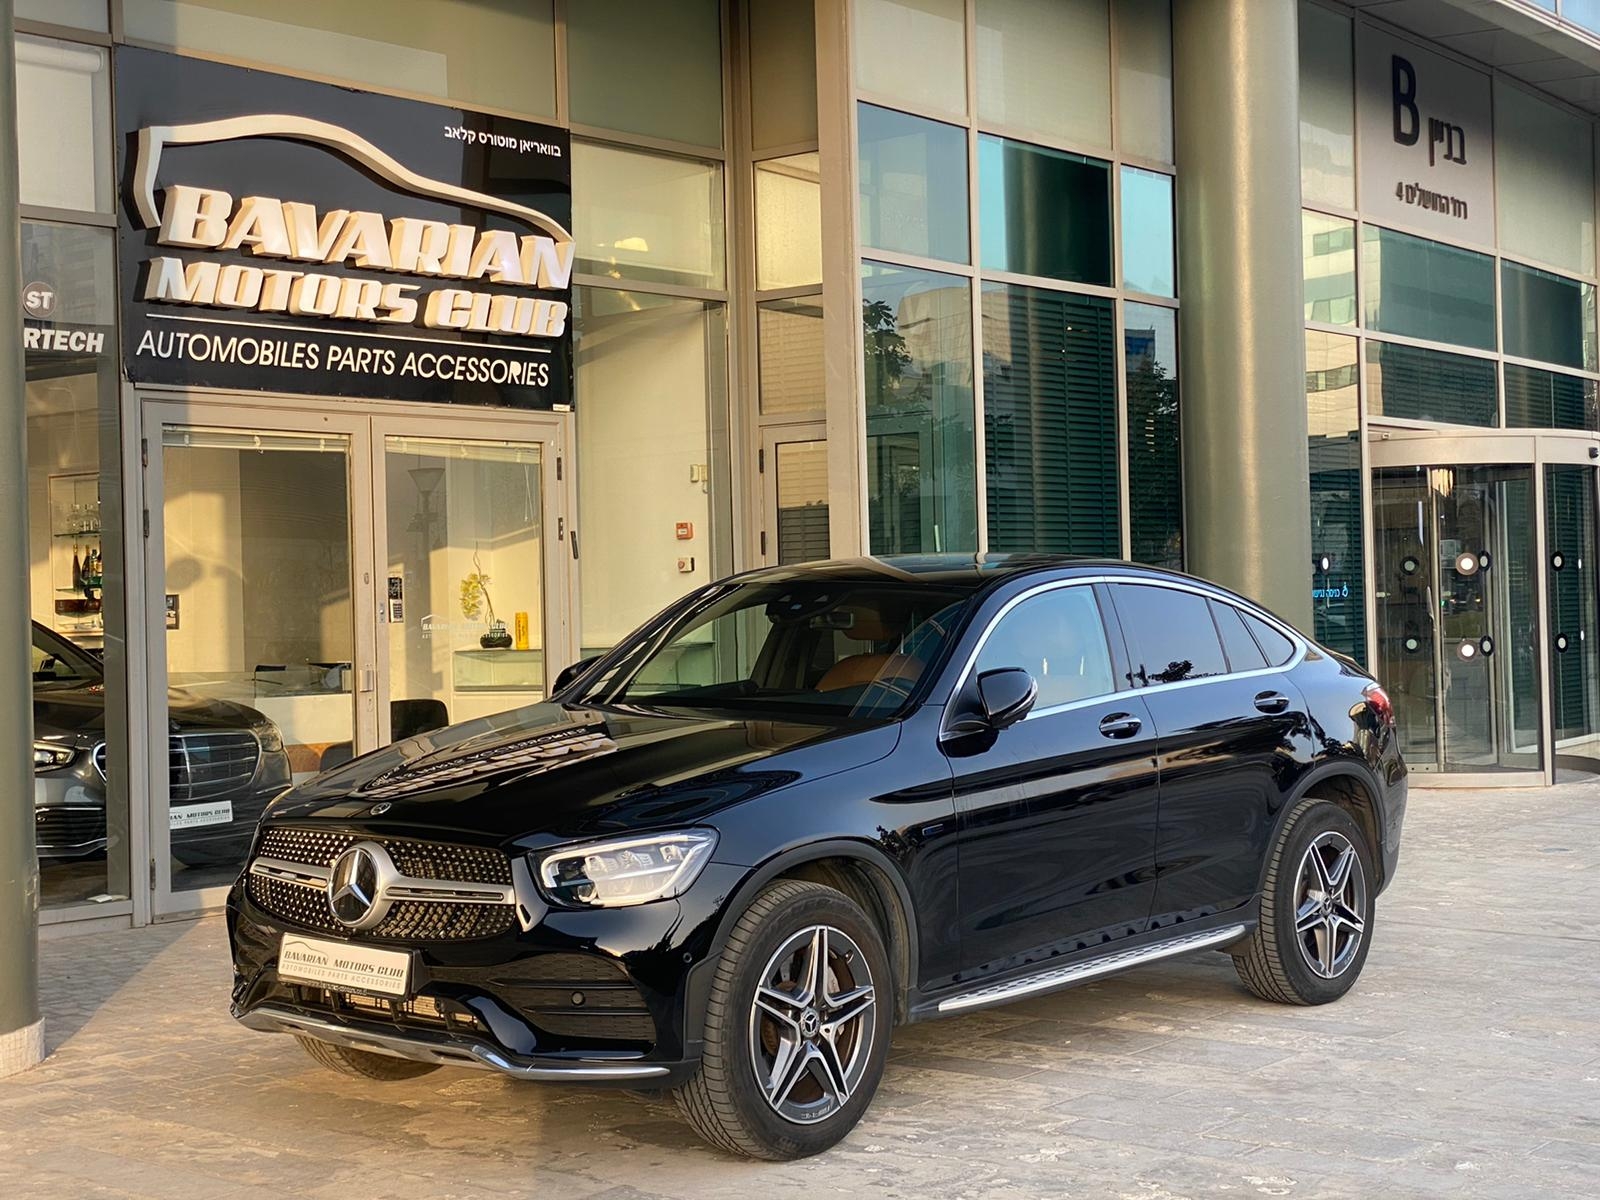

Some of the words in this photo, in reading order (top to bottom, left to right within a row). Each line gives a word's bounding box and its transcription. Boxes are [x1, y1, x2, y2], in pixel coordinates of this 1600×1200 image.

[1392, 54, 1420, 146] B
[444, 126, 477, 145] קלאב
[478, 131, 518, 150] מוטורס
[519, 139, 562, 157] בוואריאן
[1429, 117, 1467, 167] בניין
[1395, 181, 1404, 202] 4
[157, 184, 577, 290] BAVARIAN
[25, 290, 54, 310] ST
[144, 256, 422, 324] MOTORS
[424, 289, 569, 338] CLUB
[135, 329, 320, 371] AUTOMOBILES
[326, 345, 396, 377] PARTS
[400, 352, 550, 388] ACCESSORIES
[284, 951, 328, 965] BAVARIAN
[333, 959, 375, 974] MOTORS
[377, 966, 405, 978] CLUB
